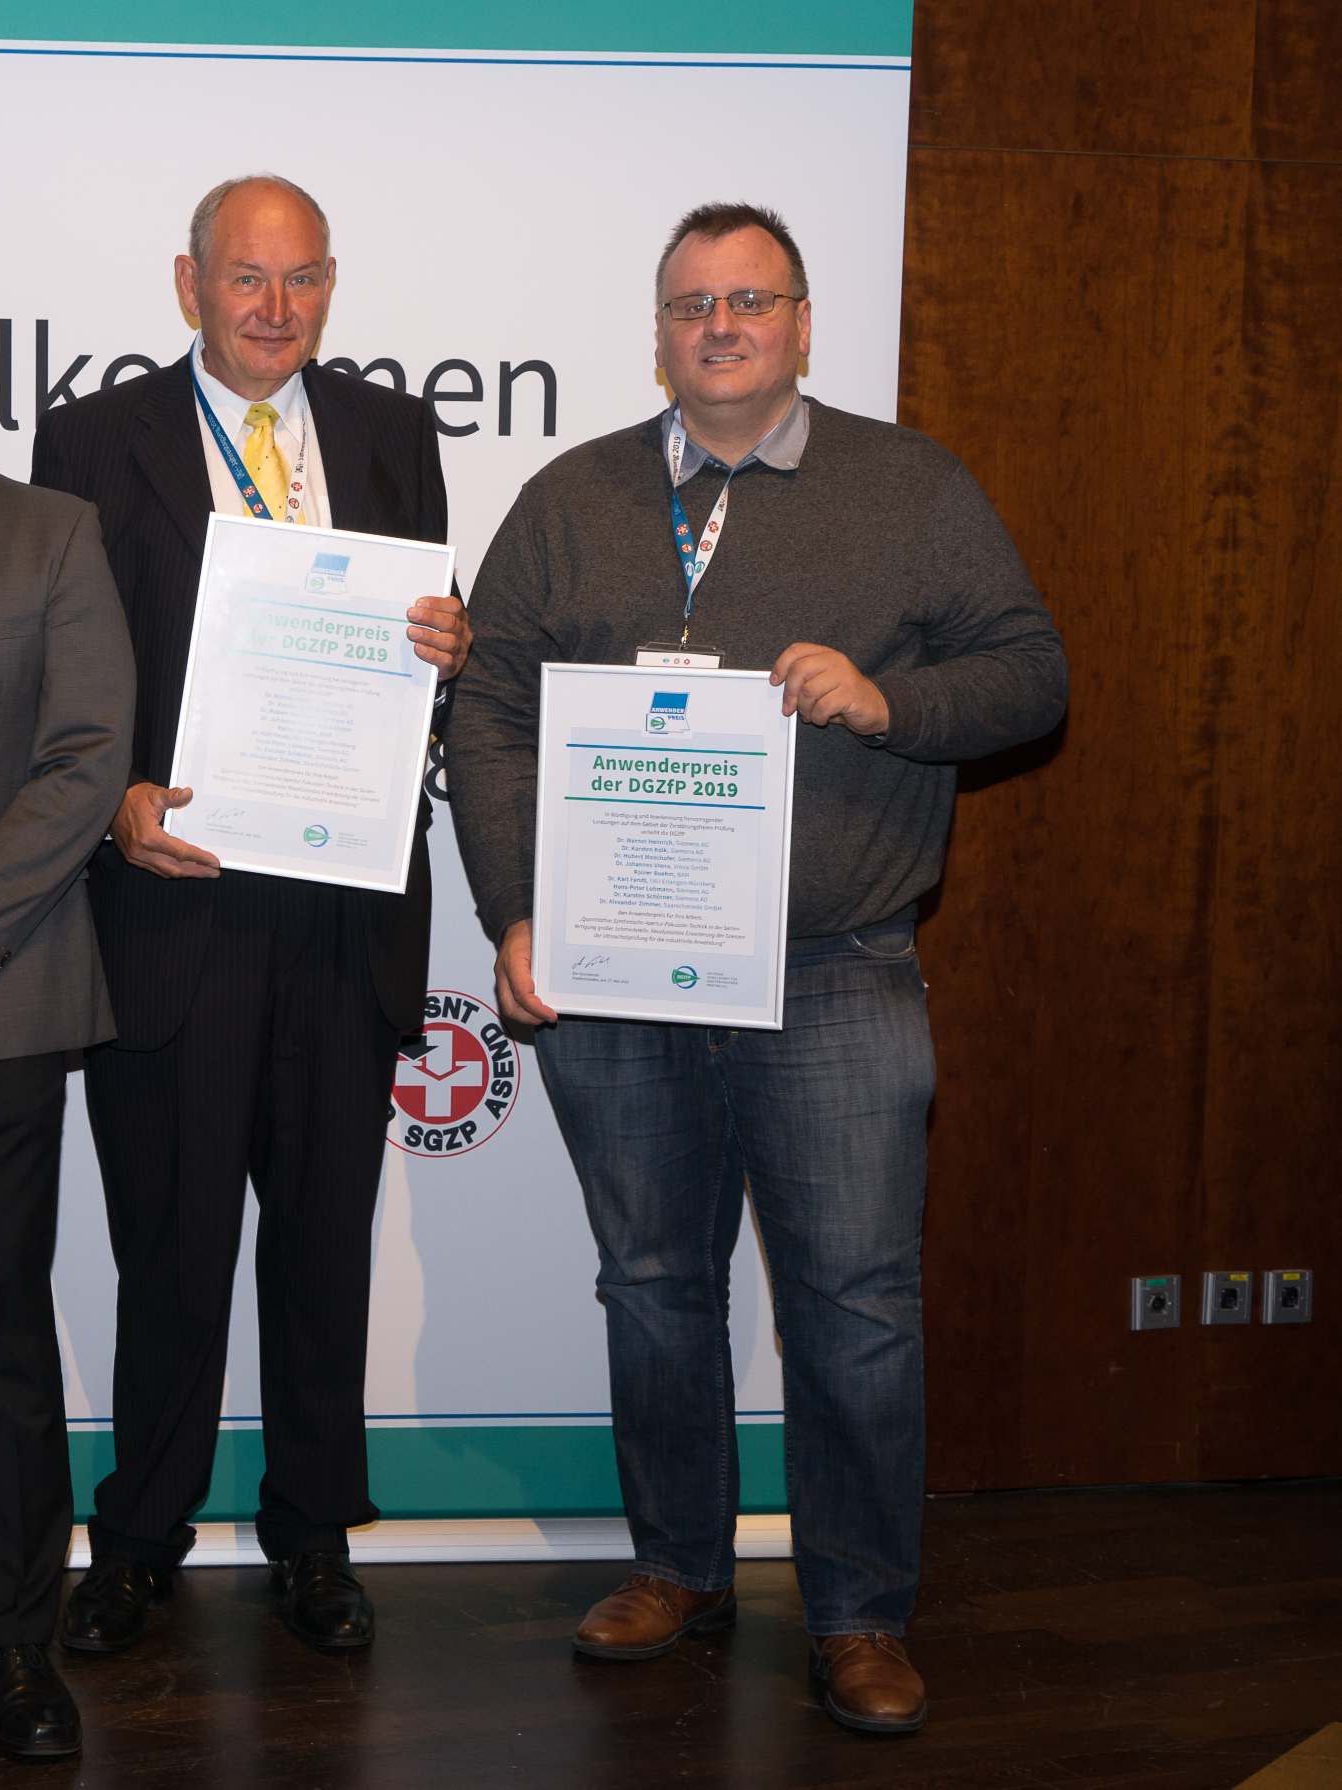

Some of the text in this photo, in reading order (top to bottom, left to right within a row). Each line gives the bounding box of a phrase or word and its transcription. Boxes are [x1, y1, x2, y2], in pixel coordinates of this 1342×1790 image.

[282, 635, 339, 655] DGZfP
[344, 643, 388, 663] 2019
[593, 755, 738, 778] Anwenderpreis
[591, 776, 738, 798] der DGZfP 2019
[404, 1120, 477, 1152] SGZP
